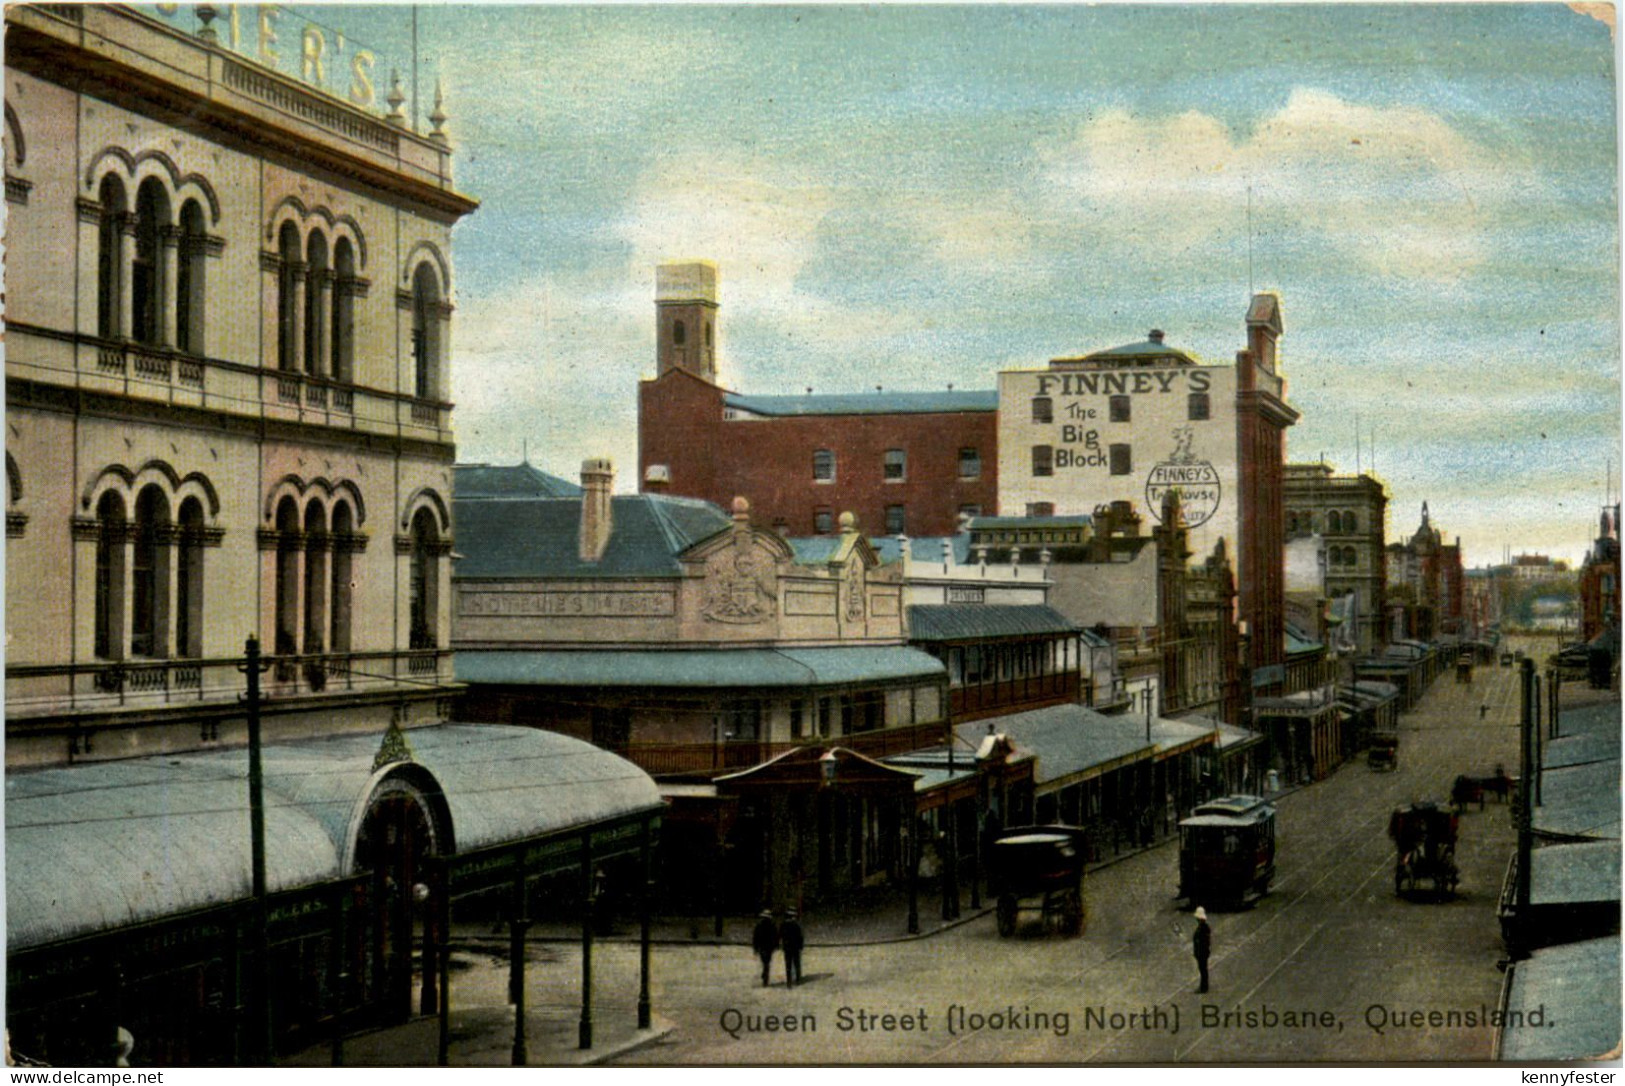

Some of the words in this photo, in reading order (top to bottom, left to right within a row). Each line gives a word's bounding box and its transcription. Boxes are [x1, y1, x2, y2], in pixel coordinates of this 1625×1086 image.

[1035, 369, 1212, 396] FINNEY'S
[1064, 401, 1097, 422] The
[1061, 424, 1100, 450] Big
[1054, 448, 1108, 468] Block
